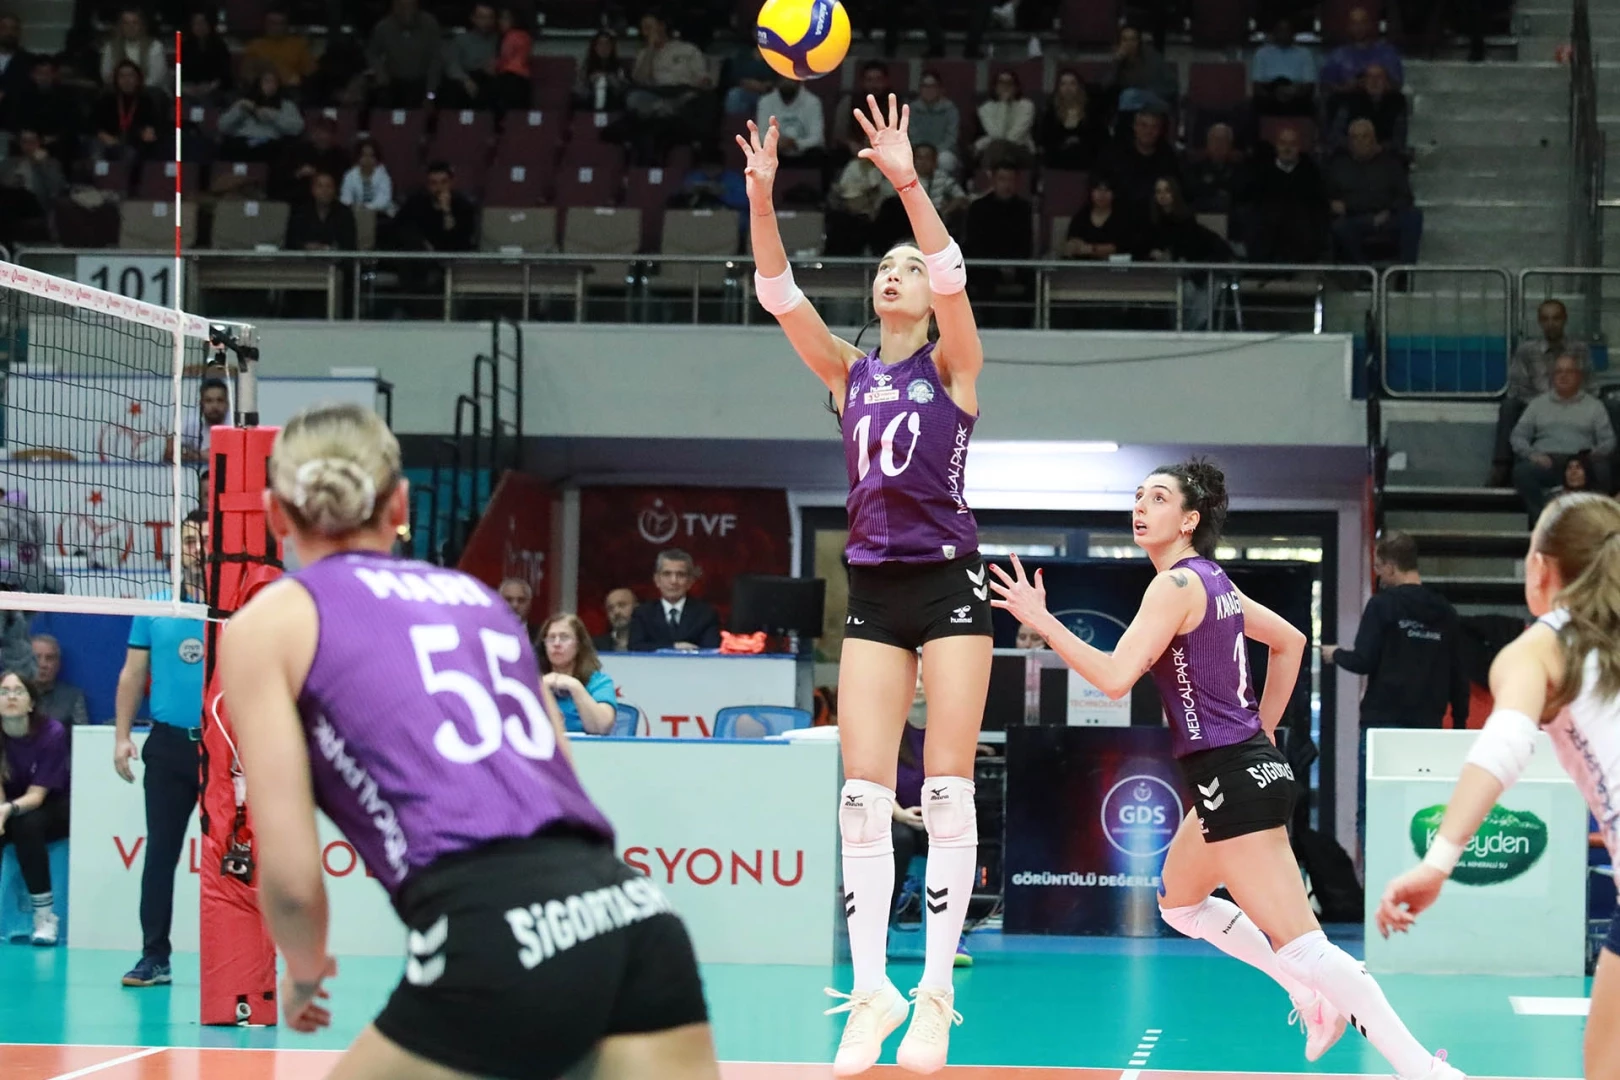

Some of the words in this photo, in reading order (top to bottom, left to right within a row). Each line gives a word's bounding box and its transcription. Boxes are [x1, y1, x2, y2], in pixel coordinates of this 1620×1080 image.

[91, 266, 170, 306] 101
[853, 411, 921, 481] 10
[683, 513, 738, 536] TVF
[950, 616, 972, 624] hummel
[1233, 632, 1249, 708] 1
[409, 624, 556, 764] 55
[1171, 647, 1203, 741] MEDICALPARK
[1118, 804, 1166, 824] GDS
[1426, 830, 1530, 858] Keyden
[1012, 871, 1097, 886] GÖRÜNTÜLÜ
[1099, 873, 1161, 887] DEĞERLE
